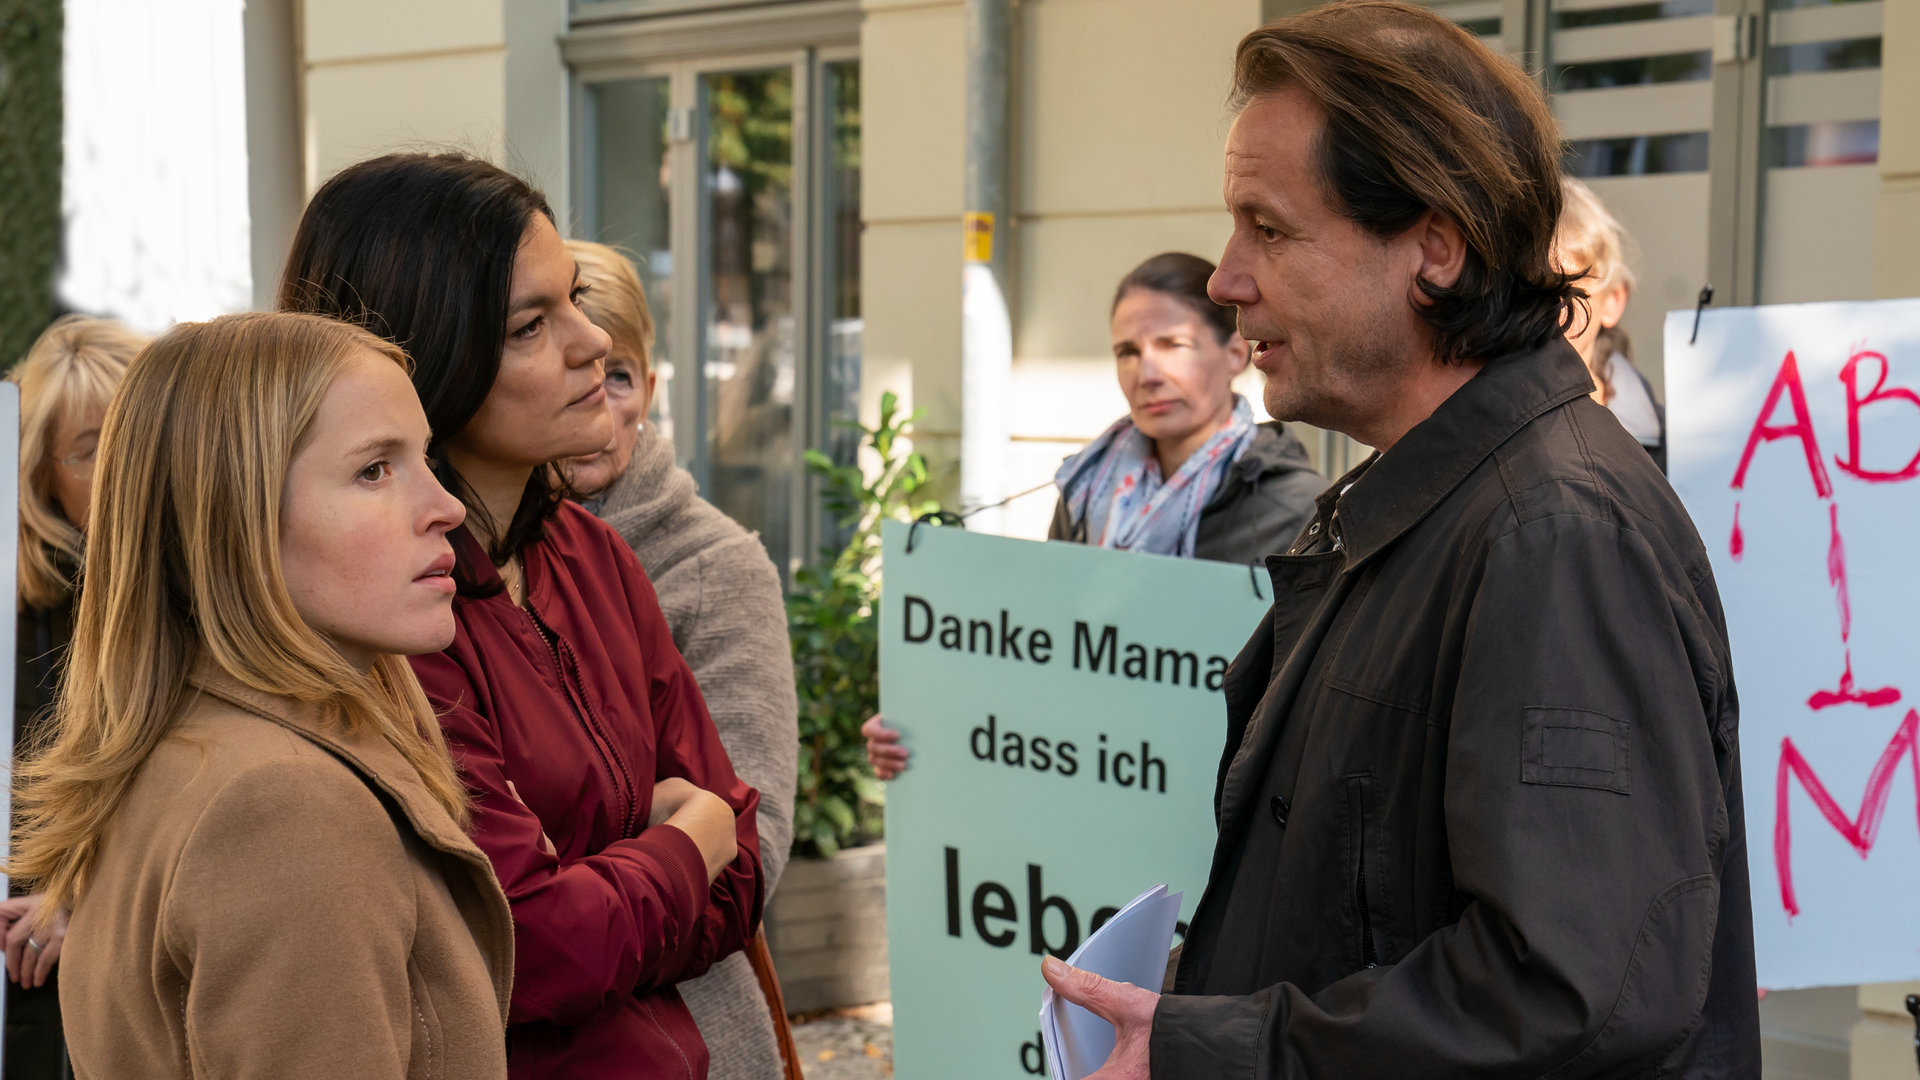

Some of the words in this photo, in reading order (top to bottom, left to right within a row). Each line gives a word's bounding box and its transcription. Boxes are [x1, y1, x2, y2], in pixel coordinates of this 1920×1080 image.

[903, 595, 1054, 665] Danke
[1072, 619, 1229, 692] Mama
[970, 714, 1079, 777] dass
[1097, 733, 1167, 794] ich
